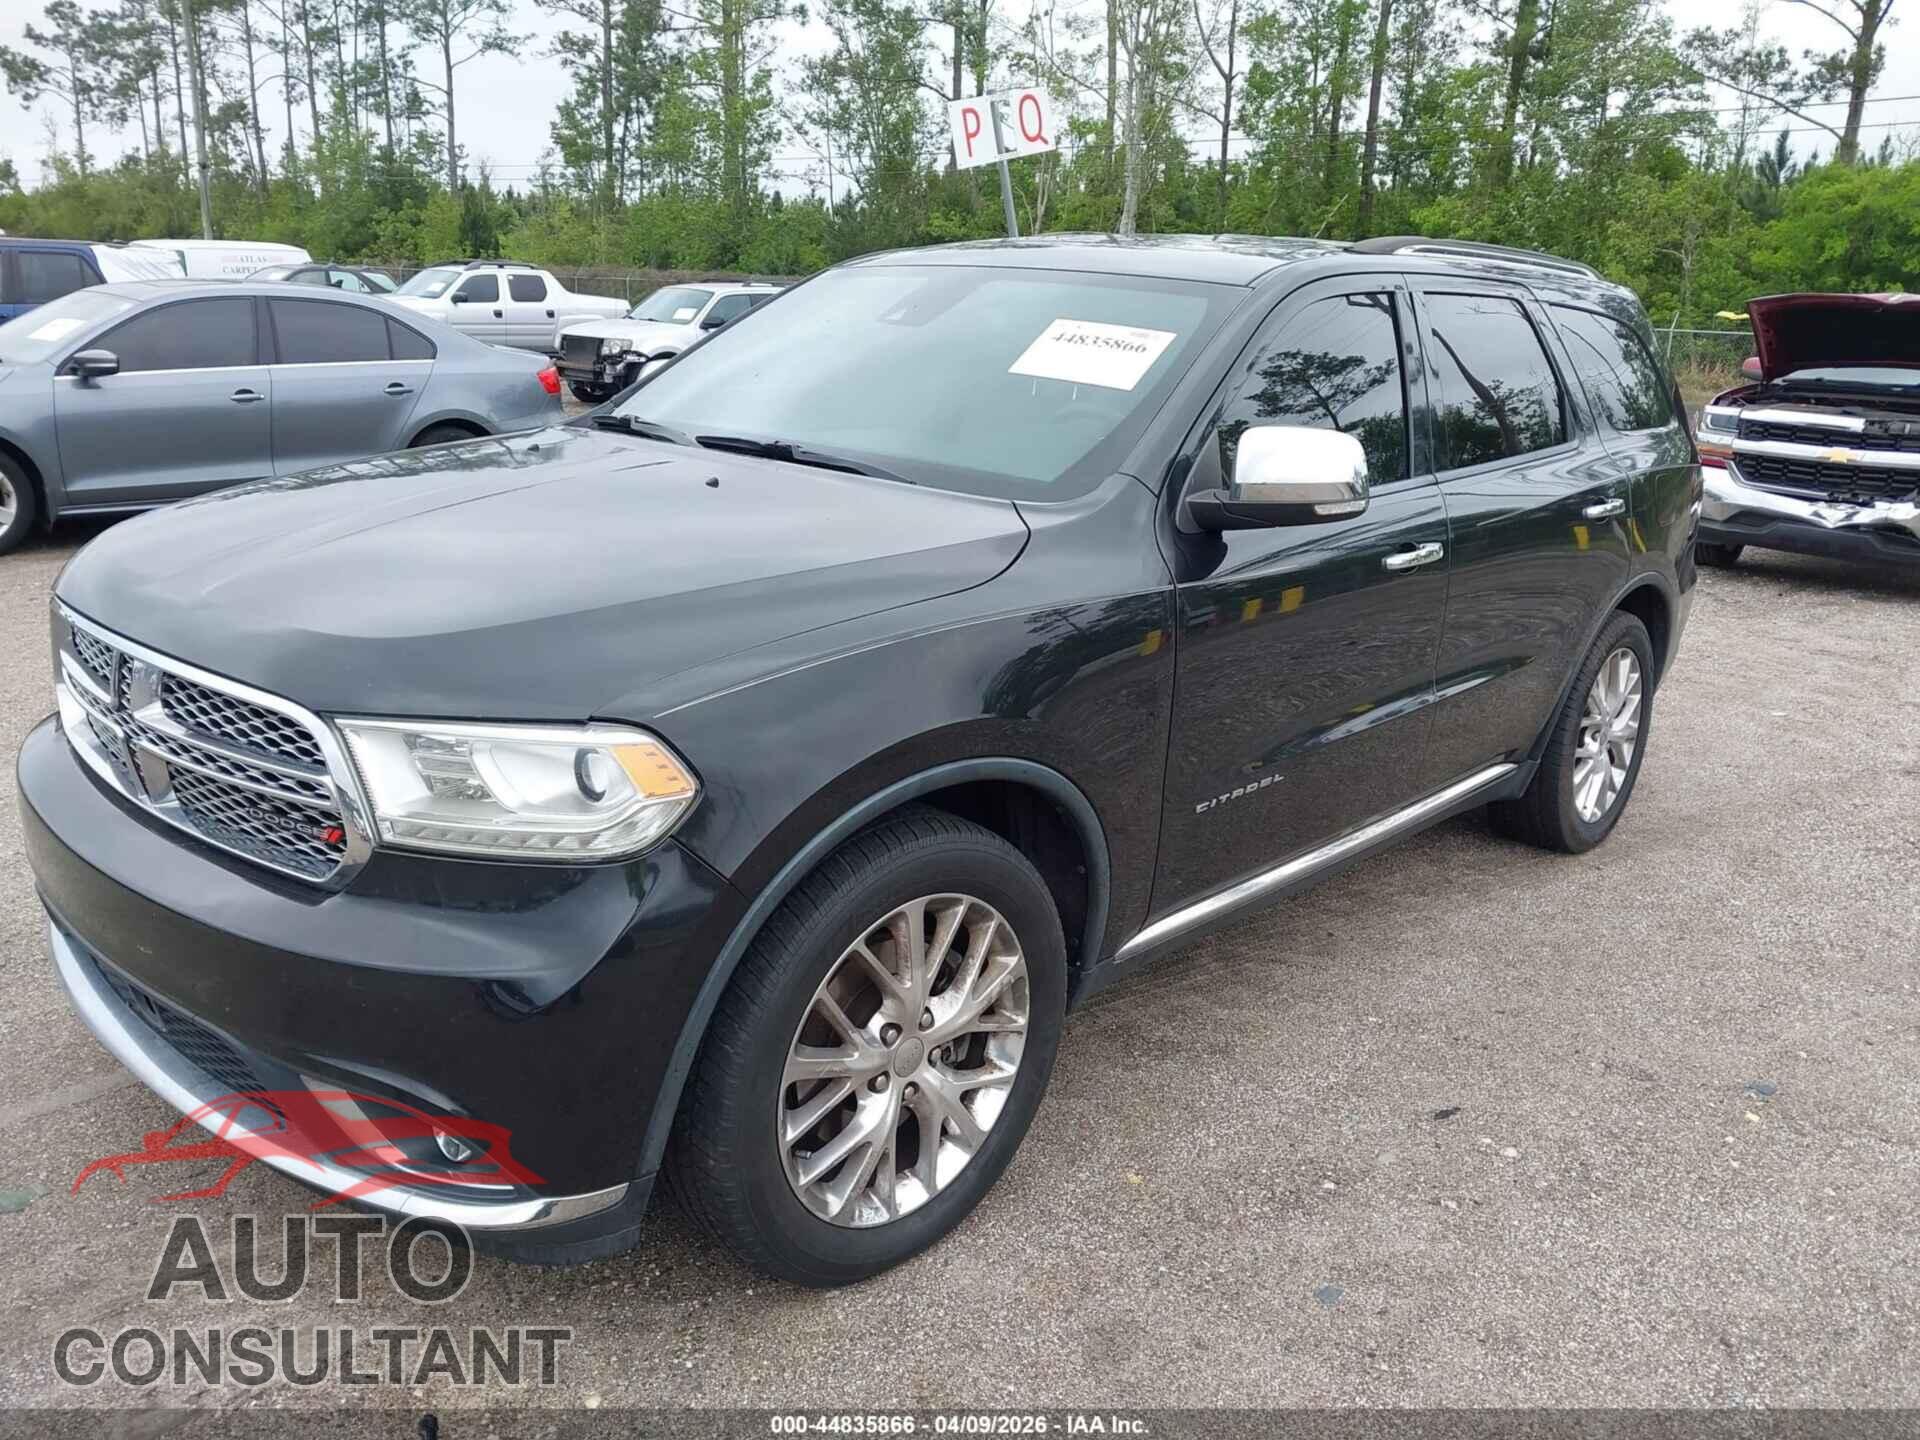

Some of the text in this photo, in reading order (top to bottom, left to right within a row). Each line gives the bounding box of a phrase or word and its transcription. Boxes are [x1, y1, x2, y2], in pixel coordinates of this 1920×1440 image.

[962, 94, 1048, 157] P Q
[1051, 332, 1147, 353] 44835866
[1196, 774, 1285, 814] CITADEL
[249, 808, 328, 838] DODGE
